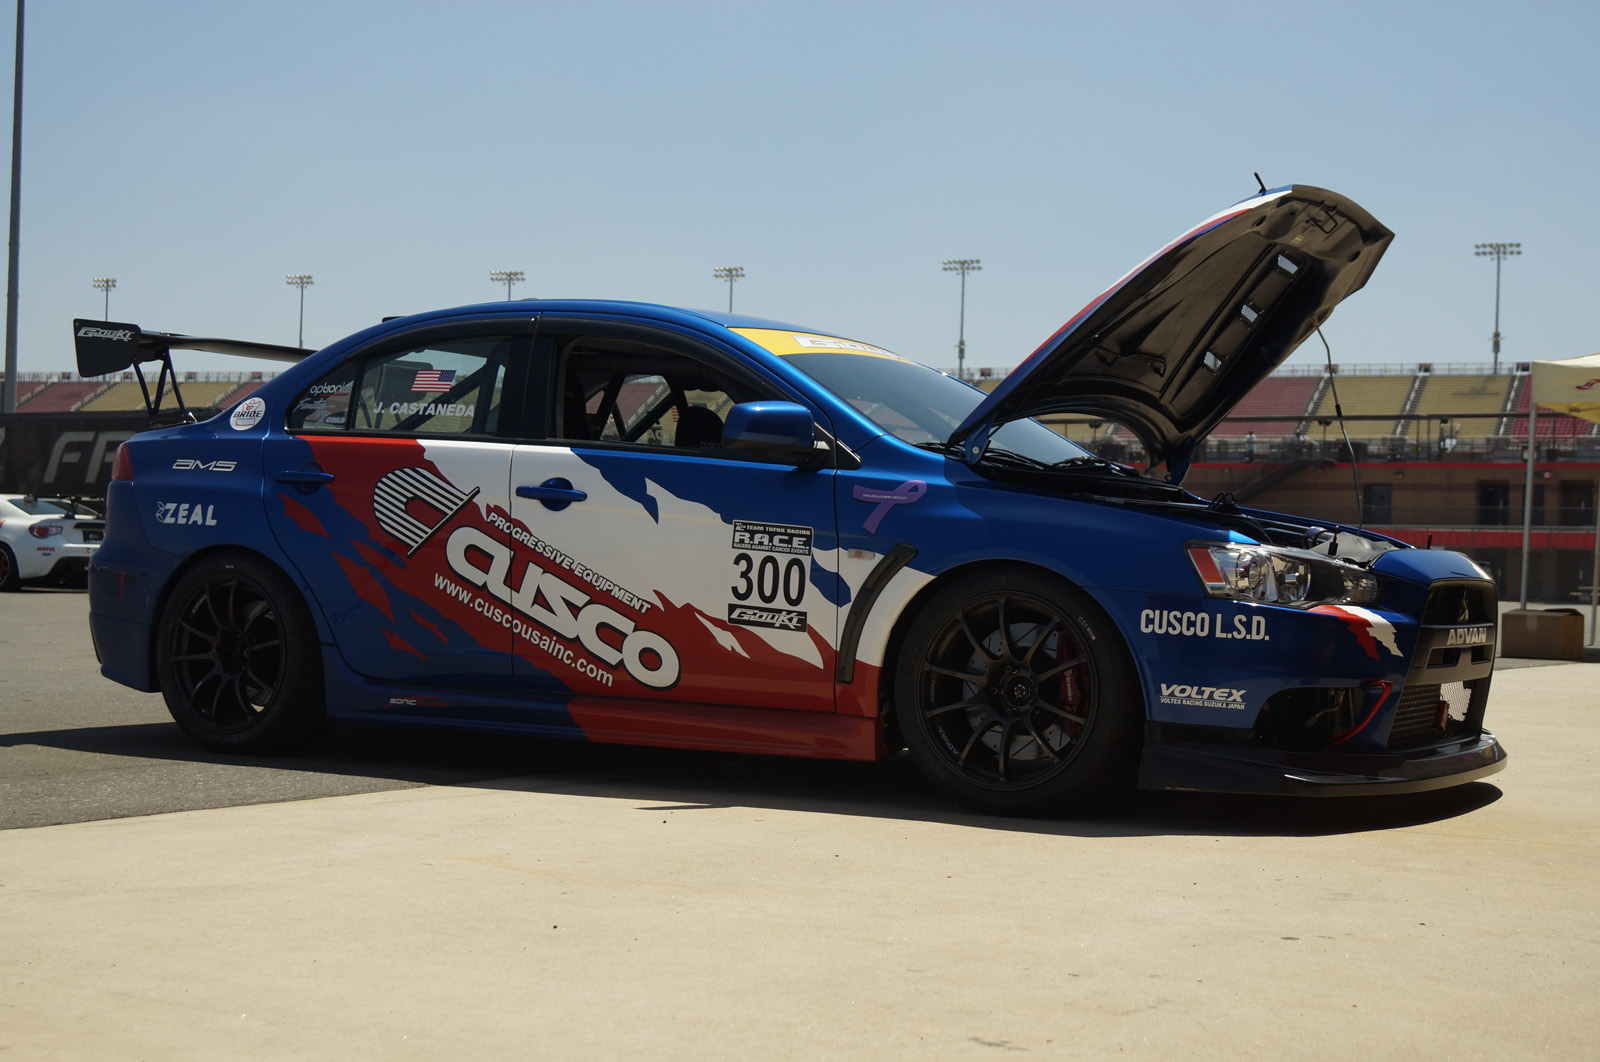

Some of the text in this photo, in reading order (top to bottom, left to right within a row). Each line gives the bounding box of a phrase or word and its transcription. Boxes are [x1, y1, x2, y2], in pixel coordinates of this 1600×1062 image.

[233, 410, 263, 418] BRIDE
[372, 402, 474, 417] J. CASTANEDA
[163, 502, 218, 526] ZEAL
[733, 531, 810, 549] R.A.C.E.
[786, 528, 811, 536] RACING
[790, 547, 809, 555] EVENTS
[487, 511, 652, 615] PROGRESSIVE EQUIPMENT
[731, 552, 806, 607] 300
[433, 572, 614, 687] www.cuscousainc.com
[1140, 609, 1270, 641] CUSCO L.S.D.
[1446, 627, 1487, 646] ADVAN
[1160, 683, 1247, 702] VOLTEX
[1160, 697, 1182, 705] VOLTEX
[1182, 698, 1204, 707] RACING
[1203, 701, 1227, 709] SUZUKA
